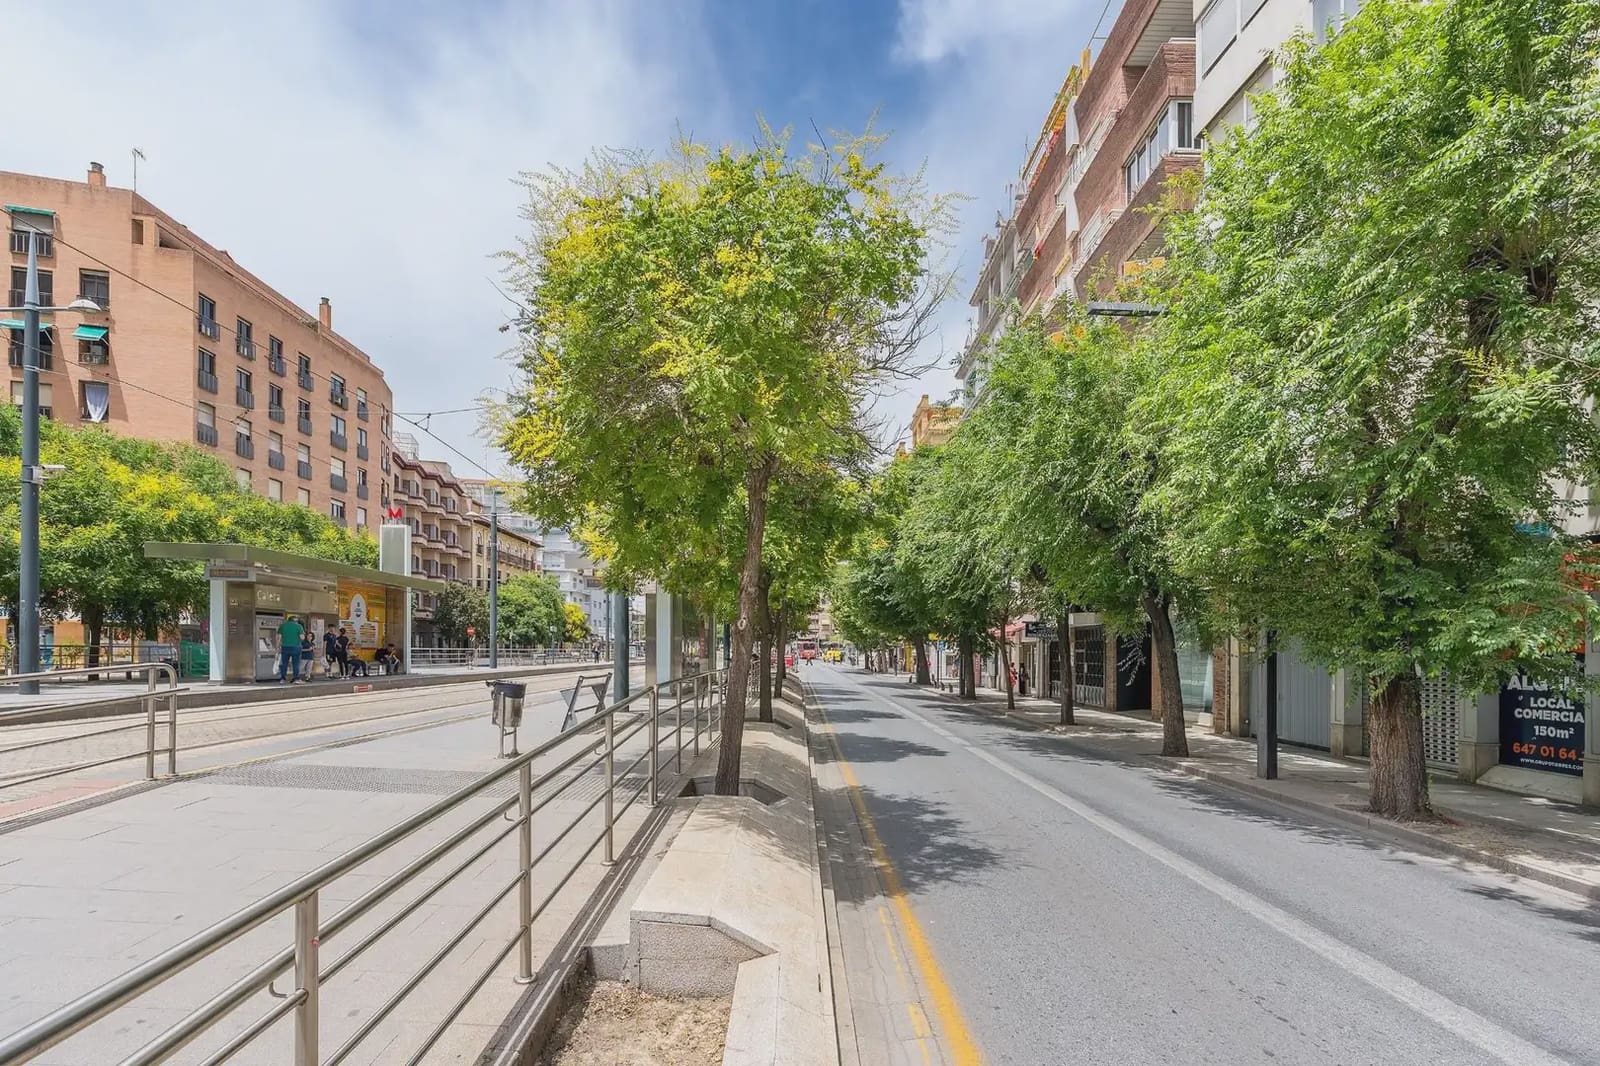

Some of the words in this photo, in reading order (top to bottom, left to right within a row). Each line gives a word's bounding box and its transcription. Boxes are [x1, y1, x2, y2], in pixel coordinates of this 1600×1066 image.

[388, 507, 403, 519] M
[1530, 697, 1575, 709] LOCAL
[1514, 708, 1584, 723] COMERCIA
[1512, 742, 1537, 755] 647
[1540, 745, 1555, 758] 01
[1558, 747, 1577, 760] 64
